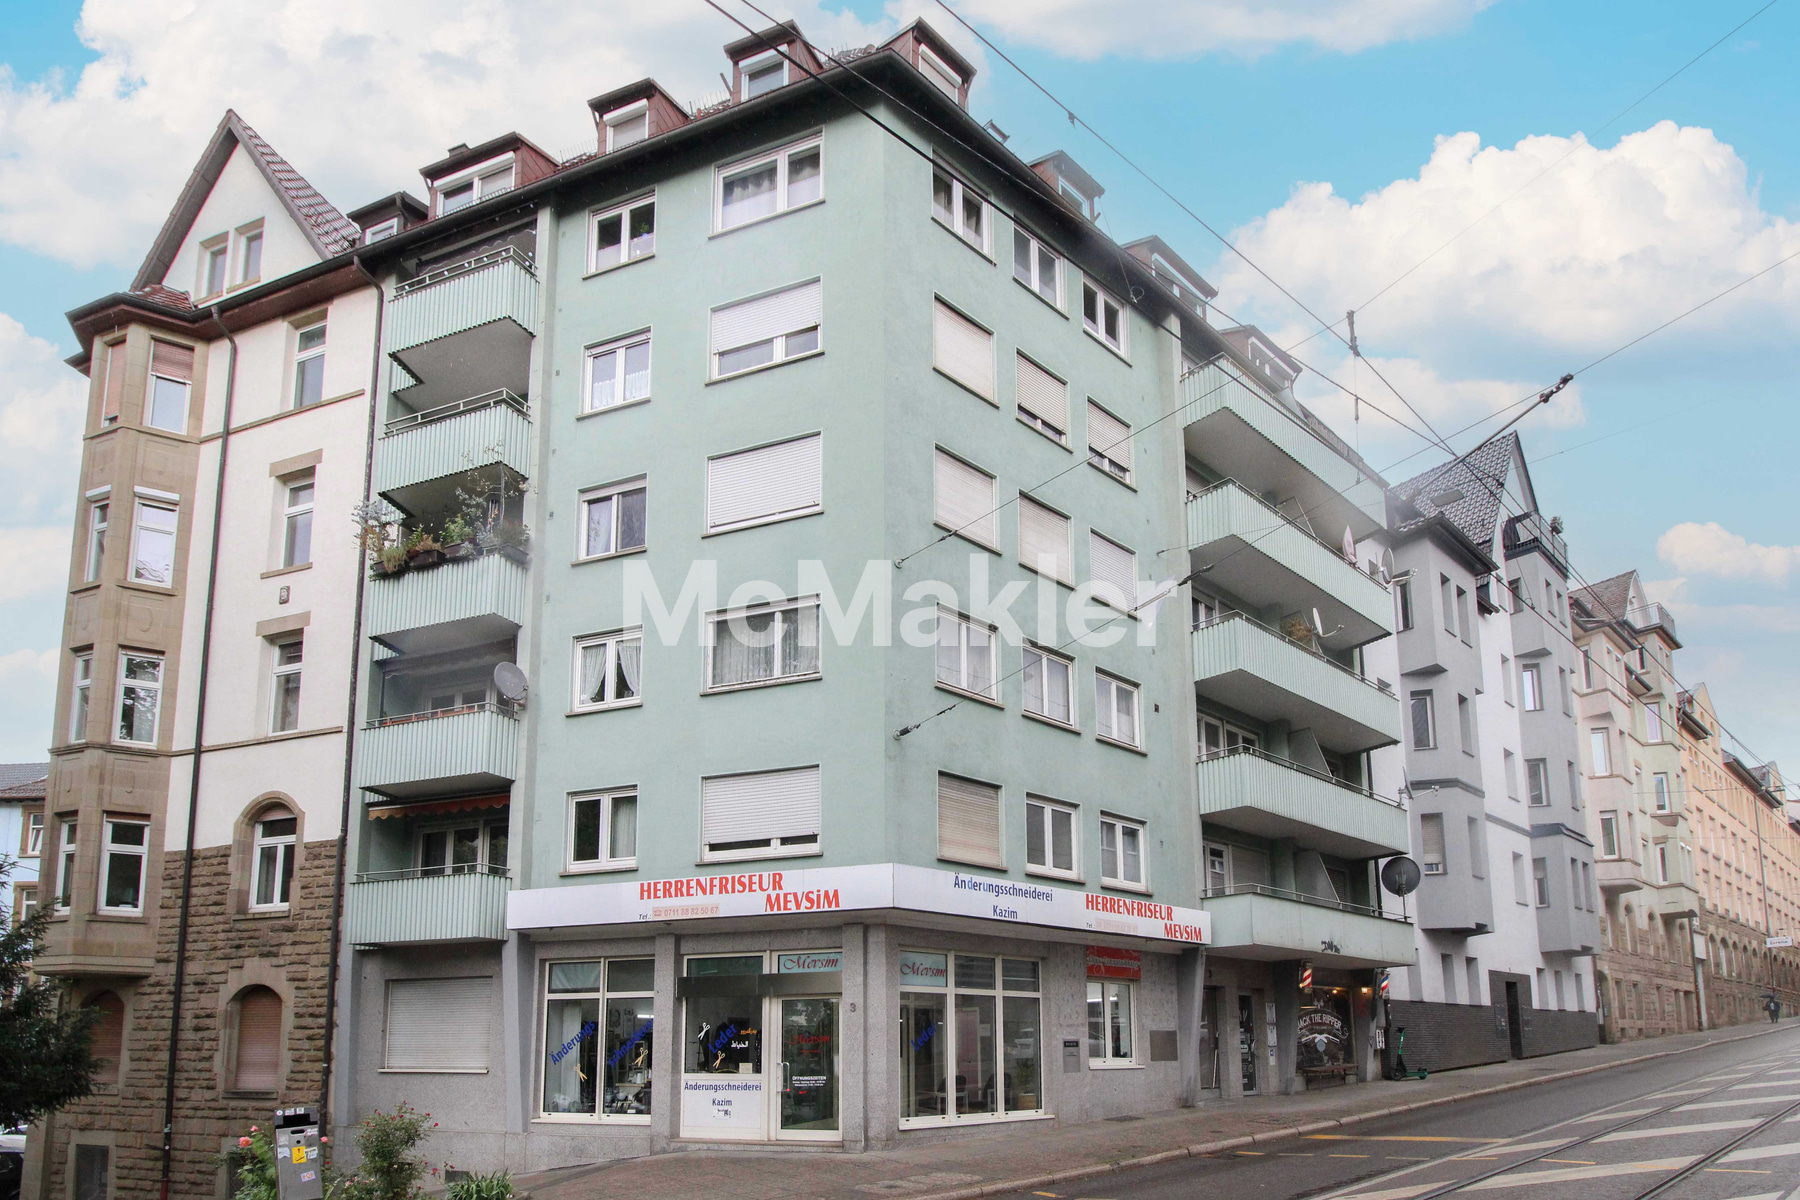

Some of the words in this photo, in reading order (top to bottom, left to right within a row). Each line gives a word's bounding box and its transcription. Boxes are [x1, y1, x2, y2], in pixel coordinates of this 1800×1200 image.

[639, 872, 784, 900] HERRENFRISEUR
[953, 872, 1053, 902] Änderungsschneiderei
[992, 904, 1018, 919] Kazim
[1085, 893, 1174, 921] HERRENFRISEUR
[783, 955, 839, 971] Mevsim
[900, 961, 946, 978] Mevsim
[850, 1003, 857, 1013] 3
[1311, 1013, 1322, 1024] THE
[1322, 1013, 1342, 1031] RIPPER
[549, 1020, 596, 1065] Änderungs
[707, 1023, 737, 1054] Leder
[910, 1022, 937, 1051] Leder
[684, 1080, 762, 1093] Änderungsschneiderei
[712, 1098, 733, 1107] Kazim
